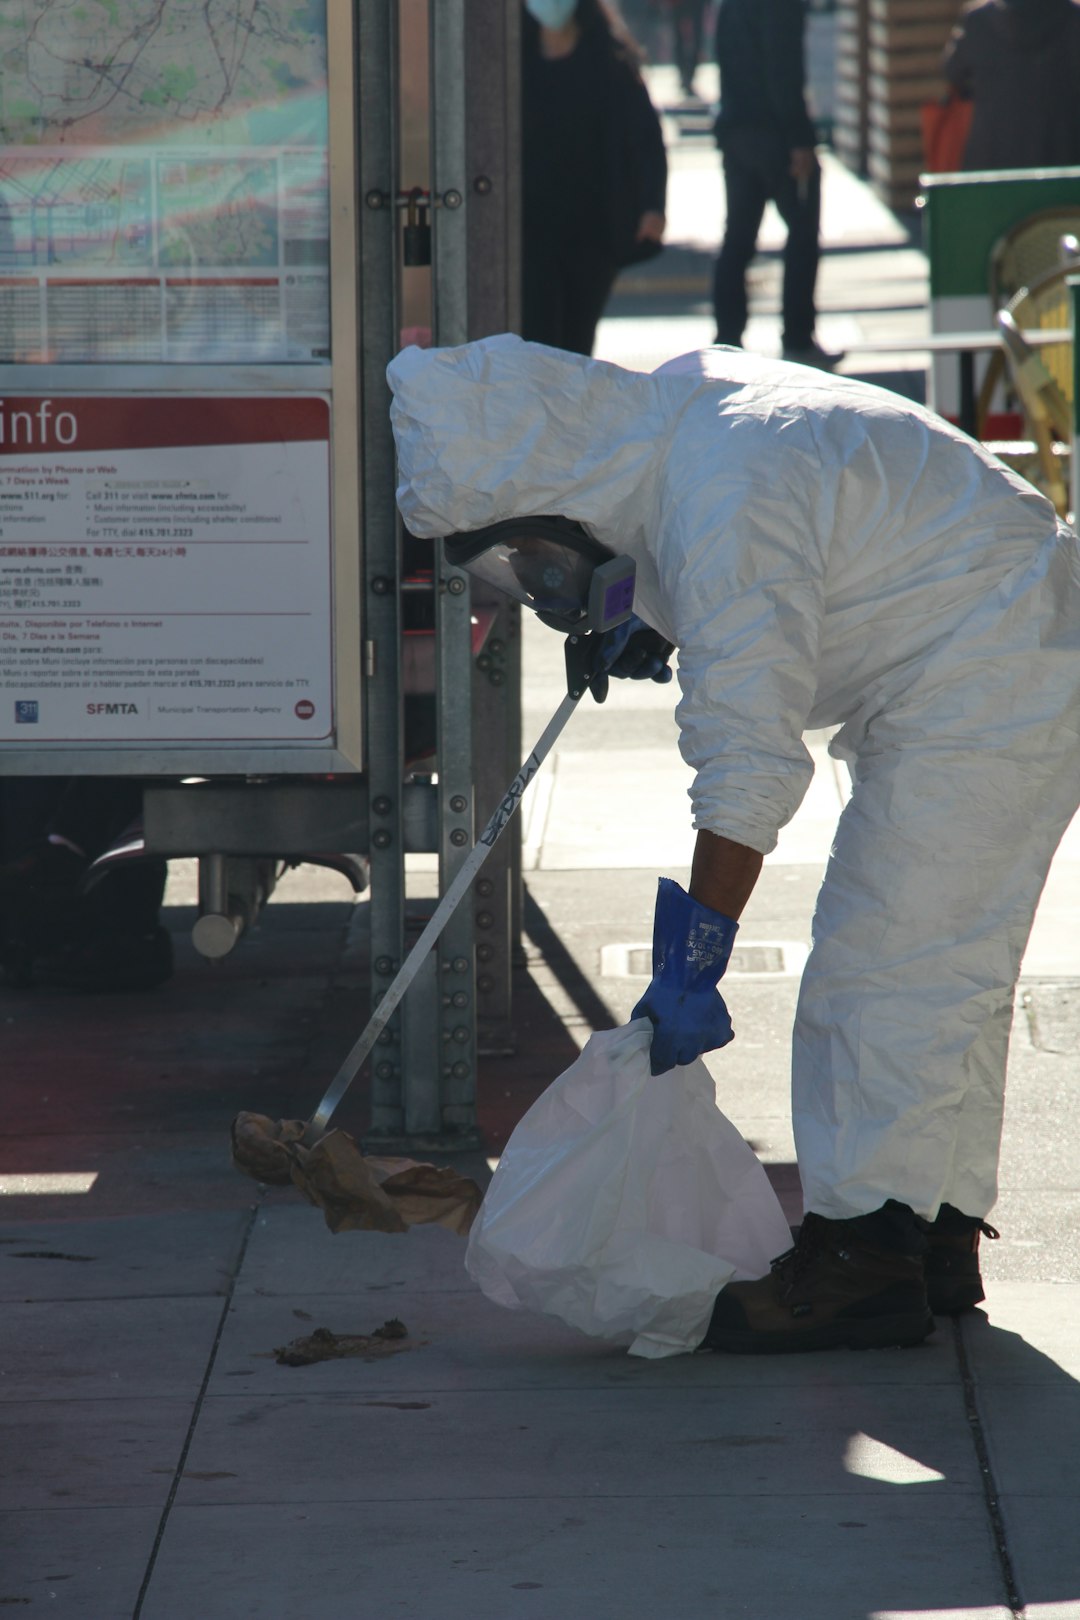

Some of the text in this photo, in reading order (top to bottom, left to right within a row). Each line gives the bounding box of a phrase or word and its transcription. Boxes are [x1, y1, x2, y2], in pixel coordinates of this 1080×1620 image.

[0, 399, 78, 445] info
[41, 465, 52, 476] by
[55, 465, 84, 474] Phone
[97, 465, 118, 474] Web
[14, 477, 36, 486] Days
[45, 477, 69, 485] Week
[86, 491, 102, 500] Call
[104, 491, 118, 500] 311
[132, 491, 149, 500] visit
[94, 503, 113, 512] Muni
[115, 503, 156, 512] information
[94, 515, 130, 523] Customer
[86, 528, 100, 537] For
[121, 528, 137, 537] dial
[25, 620, 66, 629] Disponible
[69, 622, 82, 630] por
[131, 620, 163, 628] Internet
[57, 632, 65, 640] la
[67, 632, 100, 640] Semana
[20, 702, 37, 714] 311
[86, 703, 282, 715] SFMTA Municipal Transportation Agency
